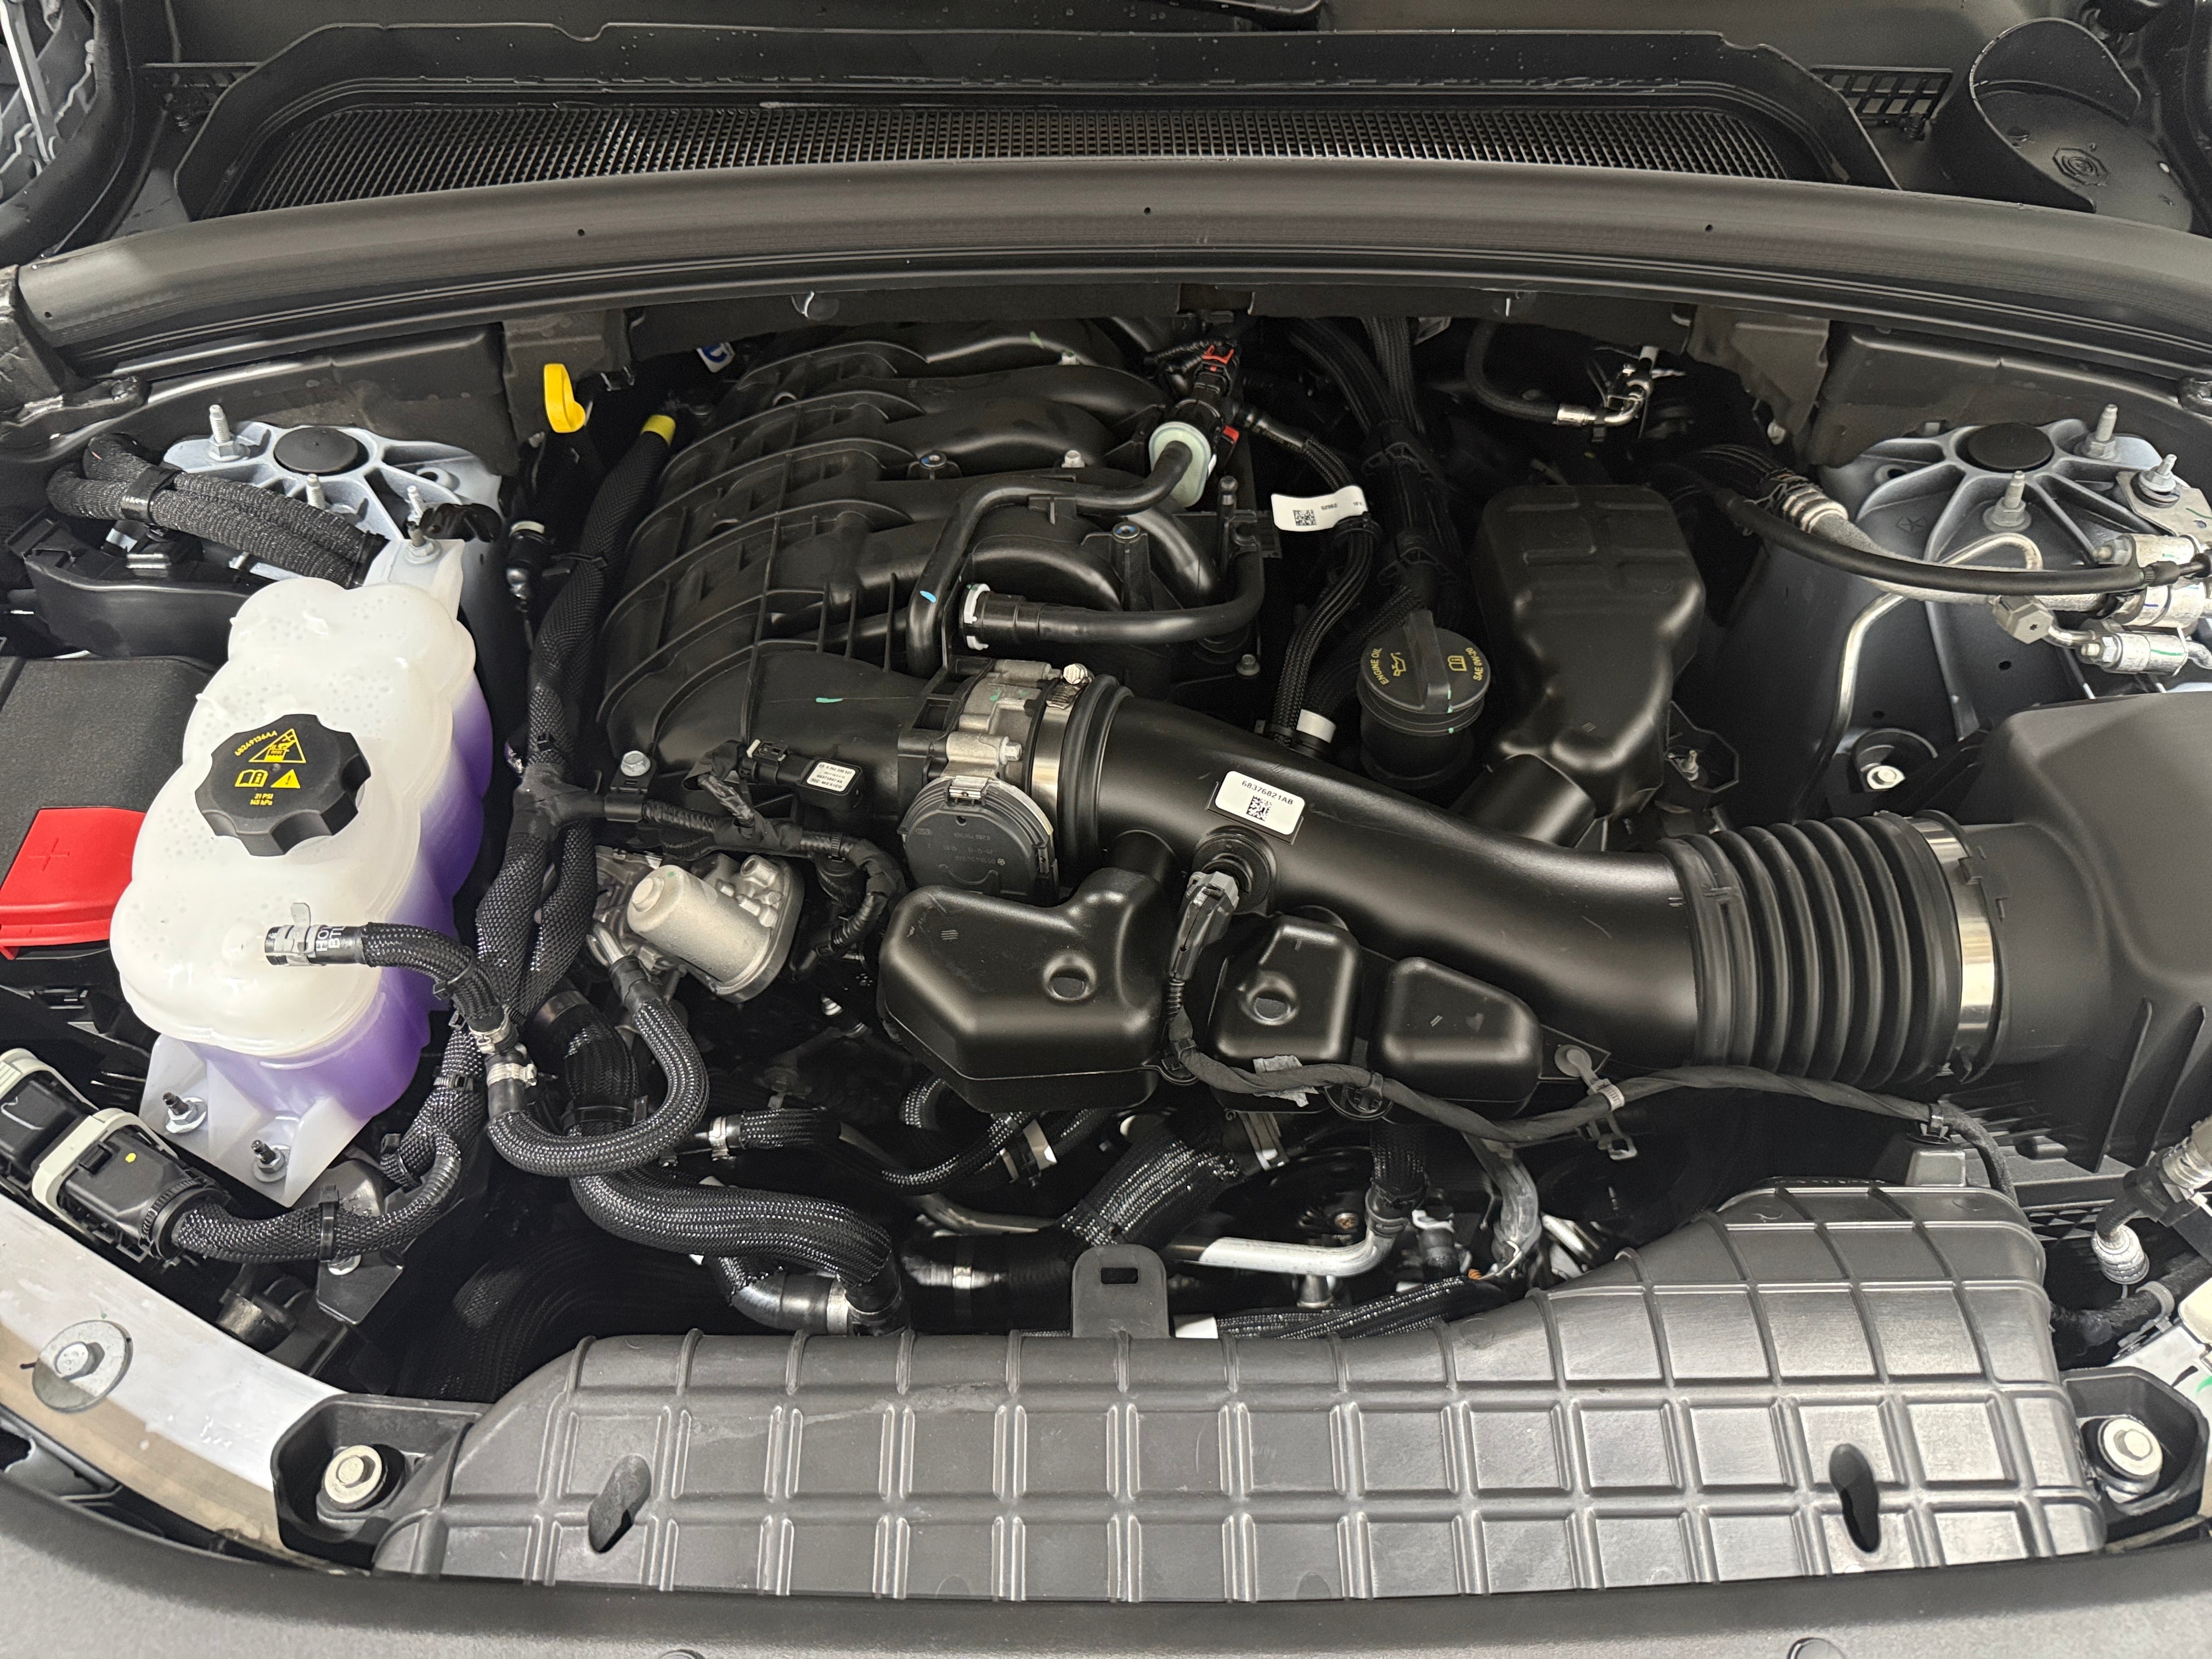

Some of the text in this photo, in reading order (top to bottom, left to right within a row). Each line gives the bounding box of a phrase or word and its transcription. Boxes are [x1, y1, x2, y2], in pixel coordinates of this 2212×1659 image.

[1370, 647, 1390, 685] ENGINE OIL
[1472, 667, 1484, 681] SAE
[1242, 780, 1294, 805] 68376821AB
[315, 926, 333, 952] HOT
[328, 926, 346, 949] BTL
